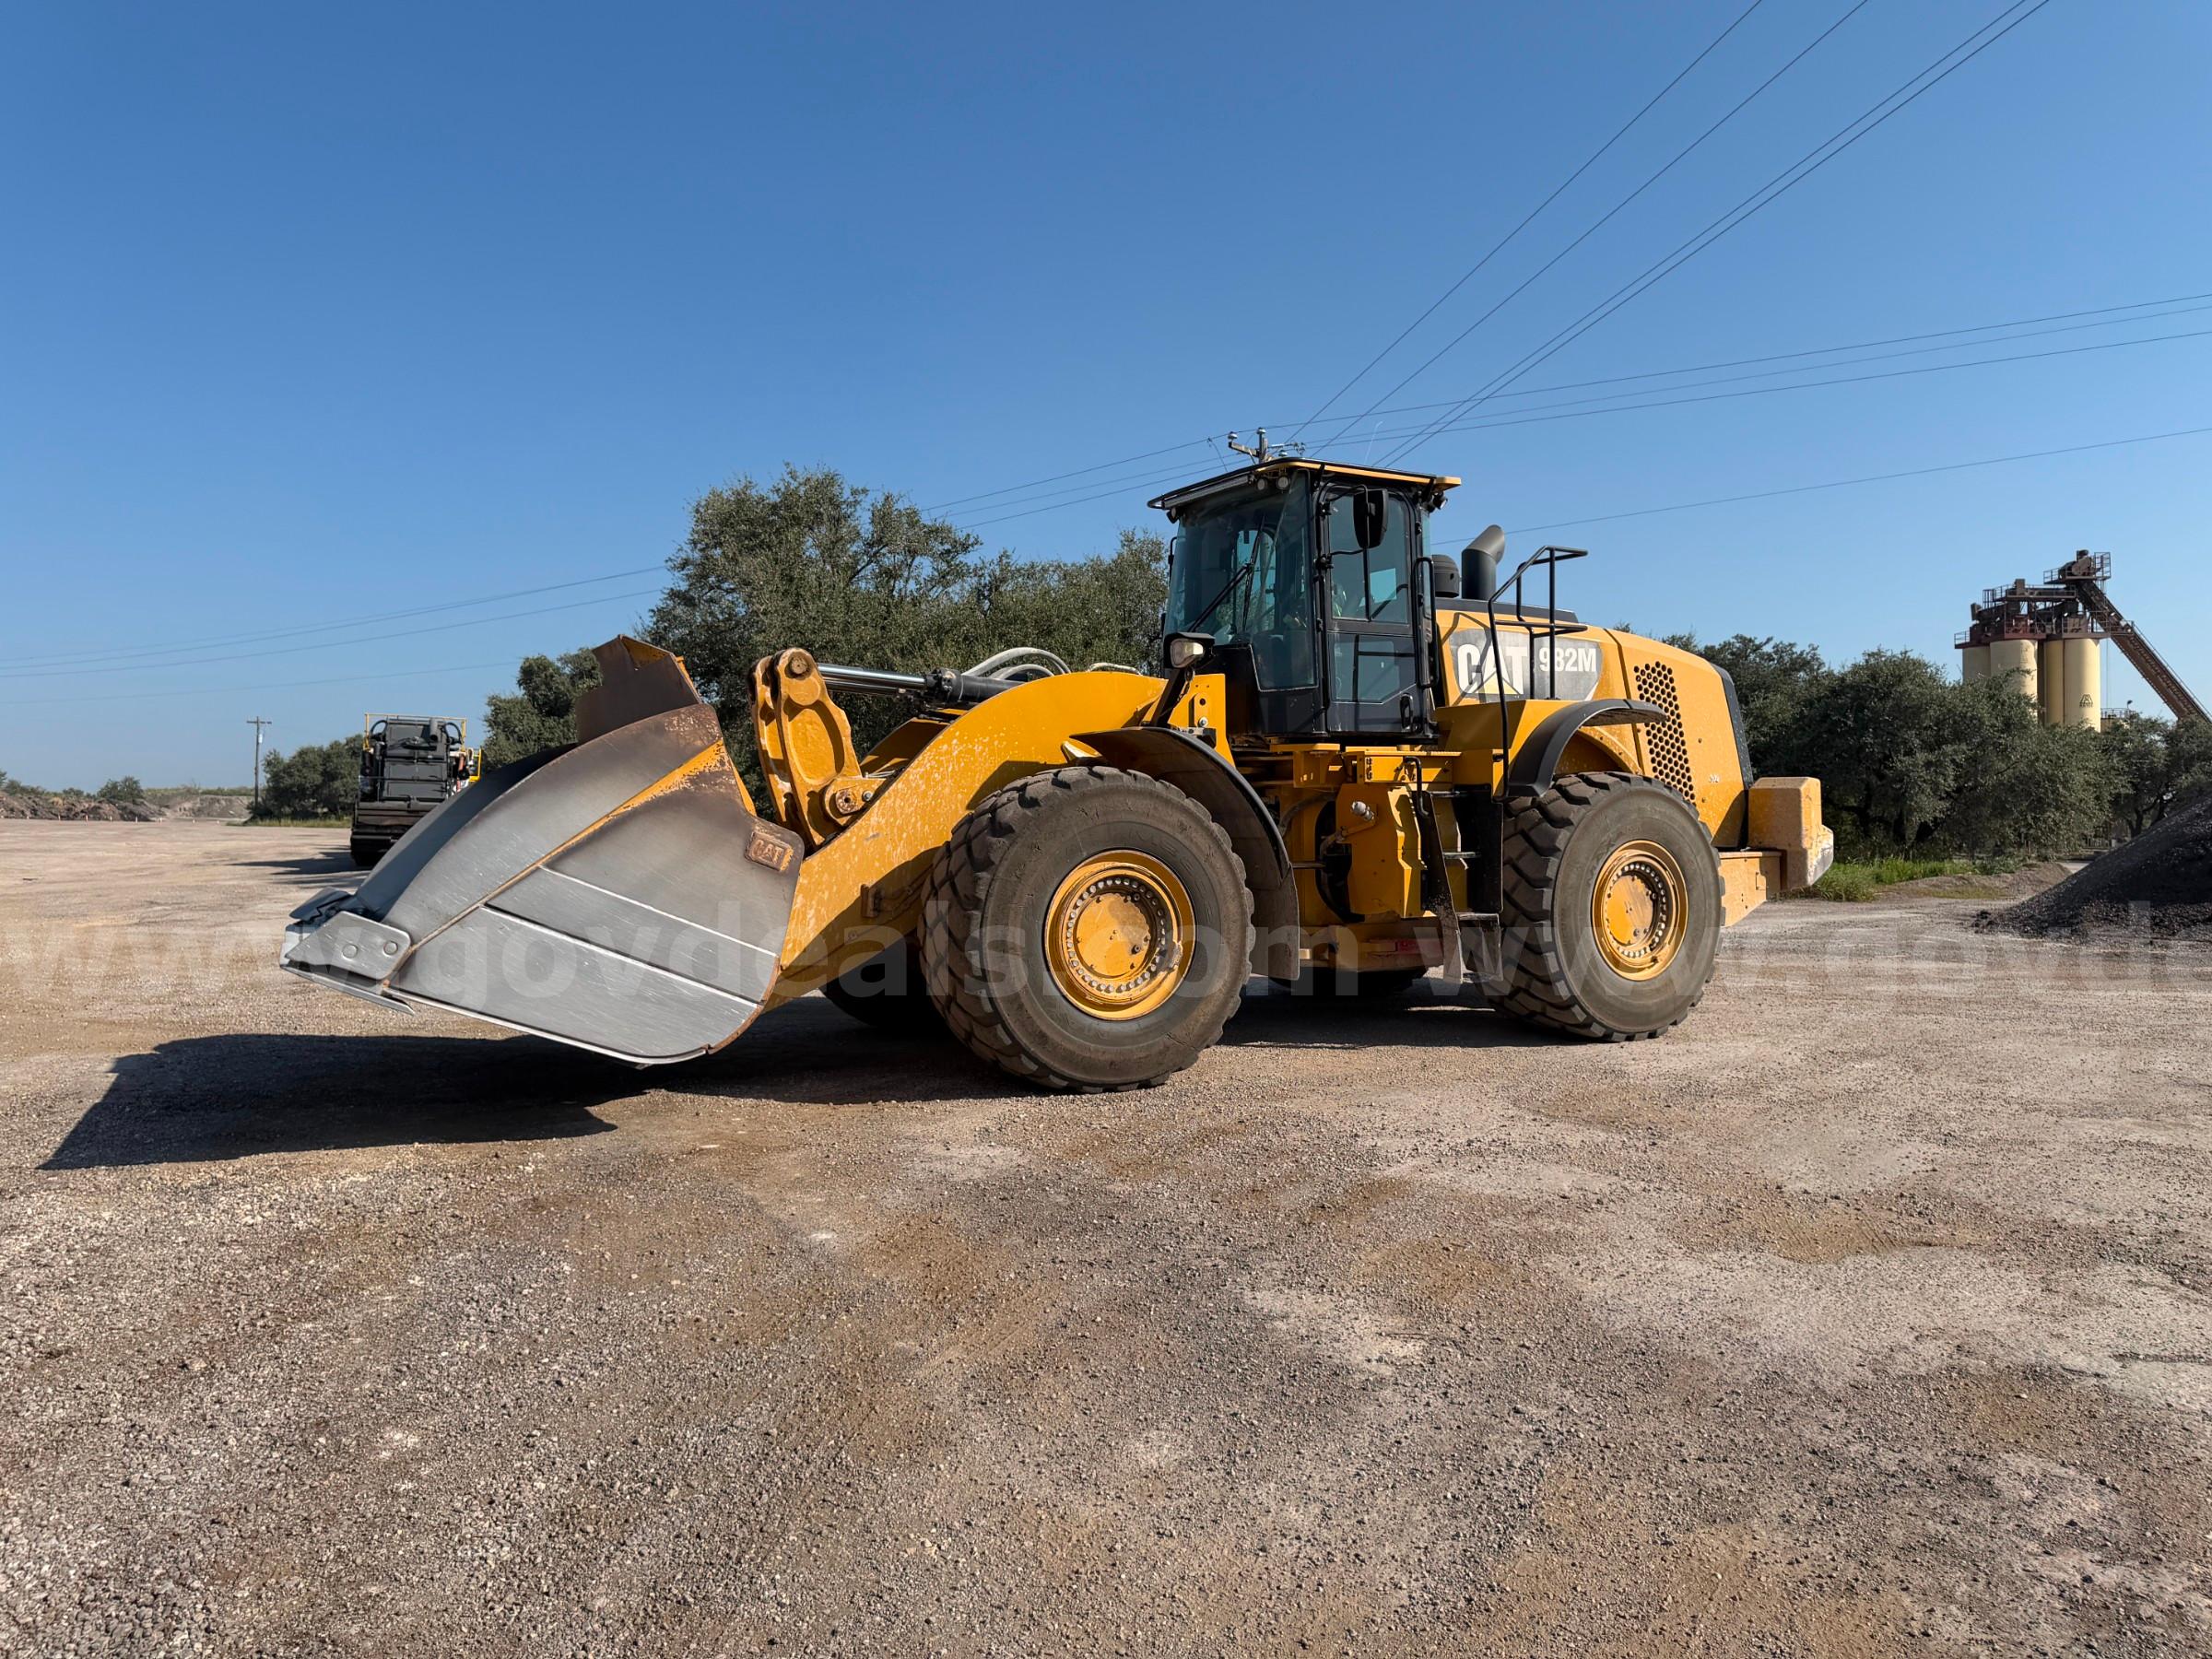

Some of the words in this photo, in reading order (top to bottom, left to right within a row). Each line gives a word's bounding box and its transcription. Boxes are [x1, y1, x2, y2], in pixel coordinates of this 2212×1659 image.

[1457, 643, 1527, 695] CAT
[1538, 647, 1597, 672] 982M
[751, 839, 784, 864] CAT
